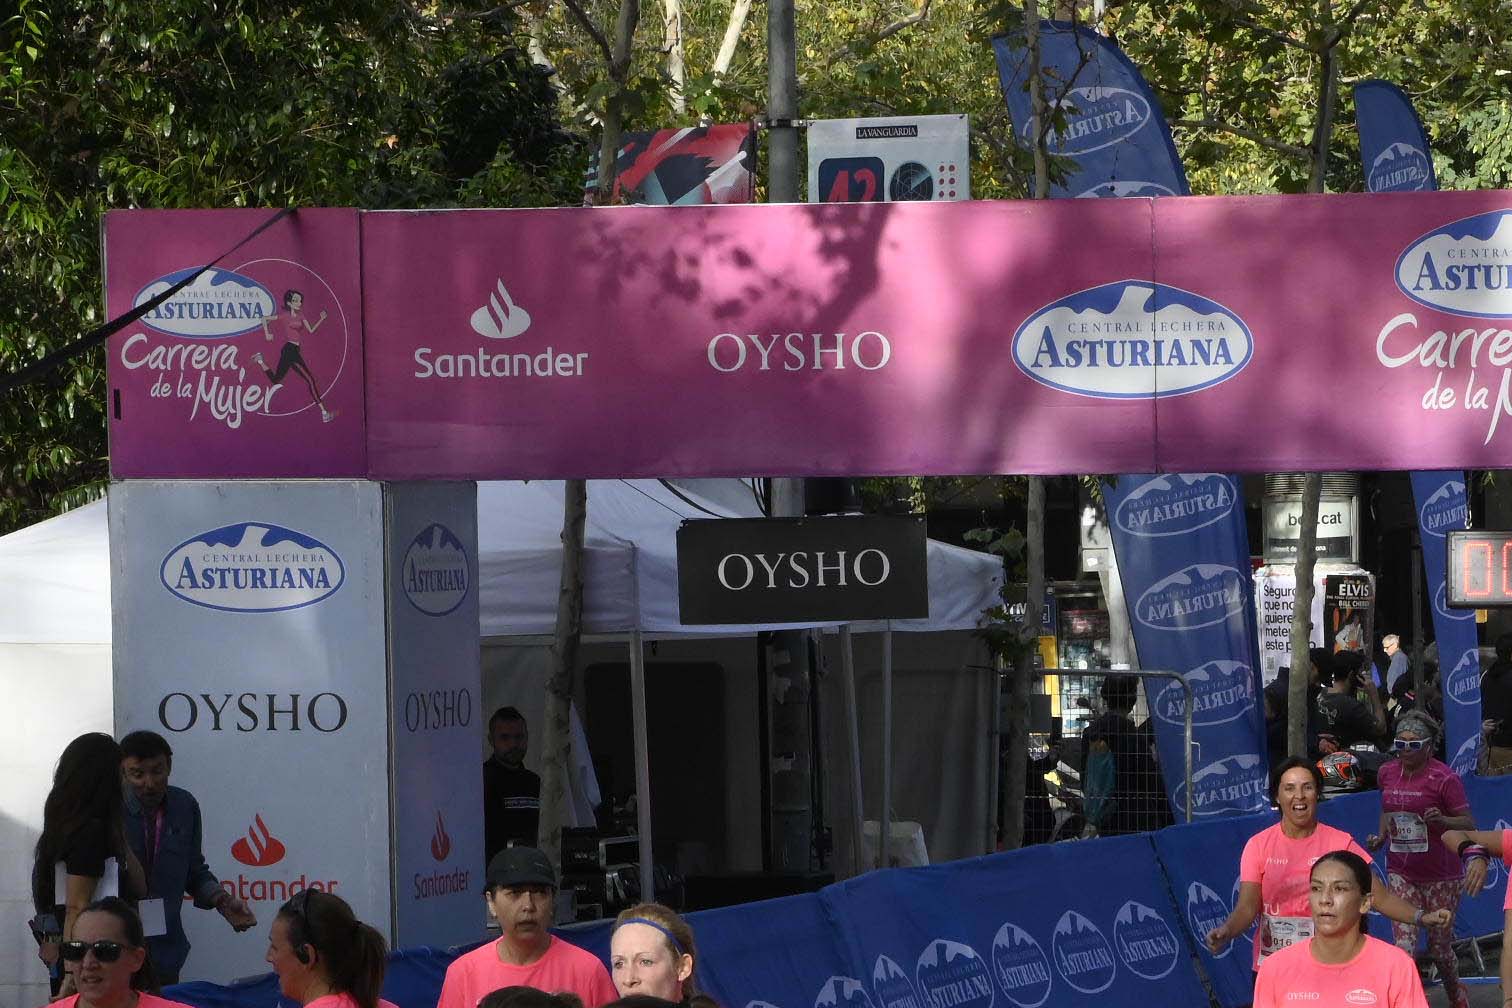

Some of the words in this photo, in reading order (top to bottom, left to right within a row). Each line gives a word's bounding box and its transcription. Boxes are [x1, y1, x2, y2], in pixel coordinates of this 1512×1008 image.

[144, 294, 264, 320] ASTURIANA
[167, 290, 208, 299] ENTRAL
[1068, 320, 1144, 333] CENTRAL
[1150, 320, 1226, 333] LECHERA
[121, 333, 238, 370] Carrera
[415, 347, 588, 380] Santander
[707, 331, 892, 372] OYSHO
[1031, 326, 1235, 370] ASTURIANA
[151, 373, 172, 398] de
[178, 371, 192, 398] la
[190, 368, 283, 429] Mujer
[1422, 372, 1456, 410] de
[1465, 367, 1488, 410] la
[175, 557, 332, 590] ASTURIANA
[203, 554, 262, 563] CENTRAL
[267, 554, 325, 563] LECHERA
[408, 557, 466, 593] ASTURIANA
[717, 549, 890, 590] OYSHO
[1339, 584, 1369, 596] ELVIS
[1264, 601, 1280, 613] que
[1265, 640, 1284, 651] este
[159, 692, 348, 733] OYSHO
[405, 688, 472, 733] OYSHO
[414, 869, 471, 900] Santander
[1273, 938, 1292, 947] 016
[1288, 992, 1320, 1000] OYSHO
